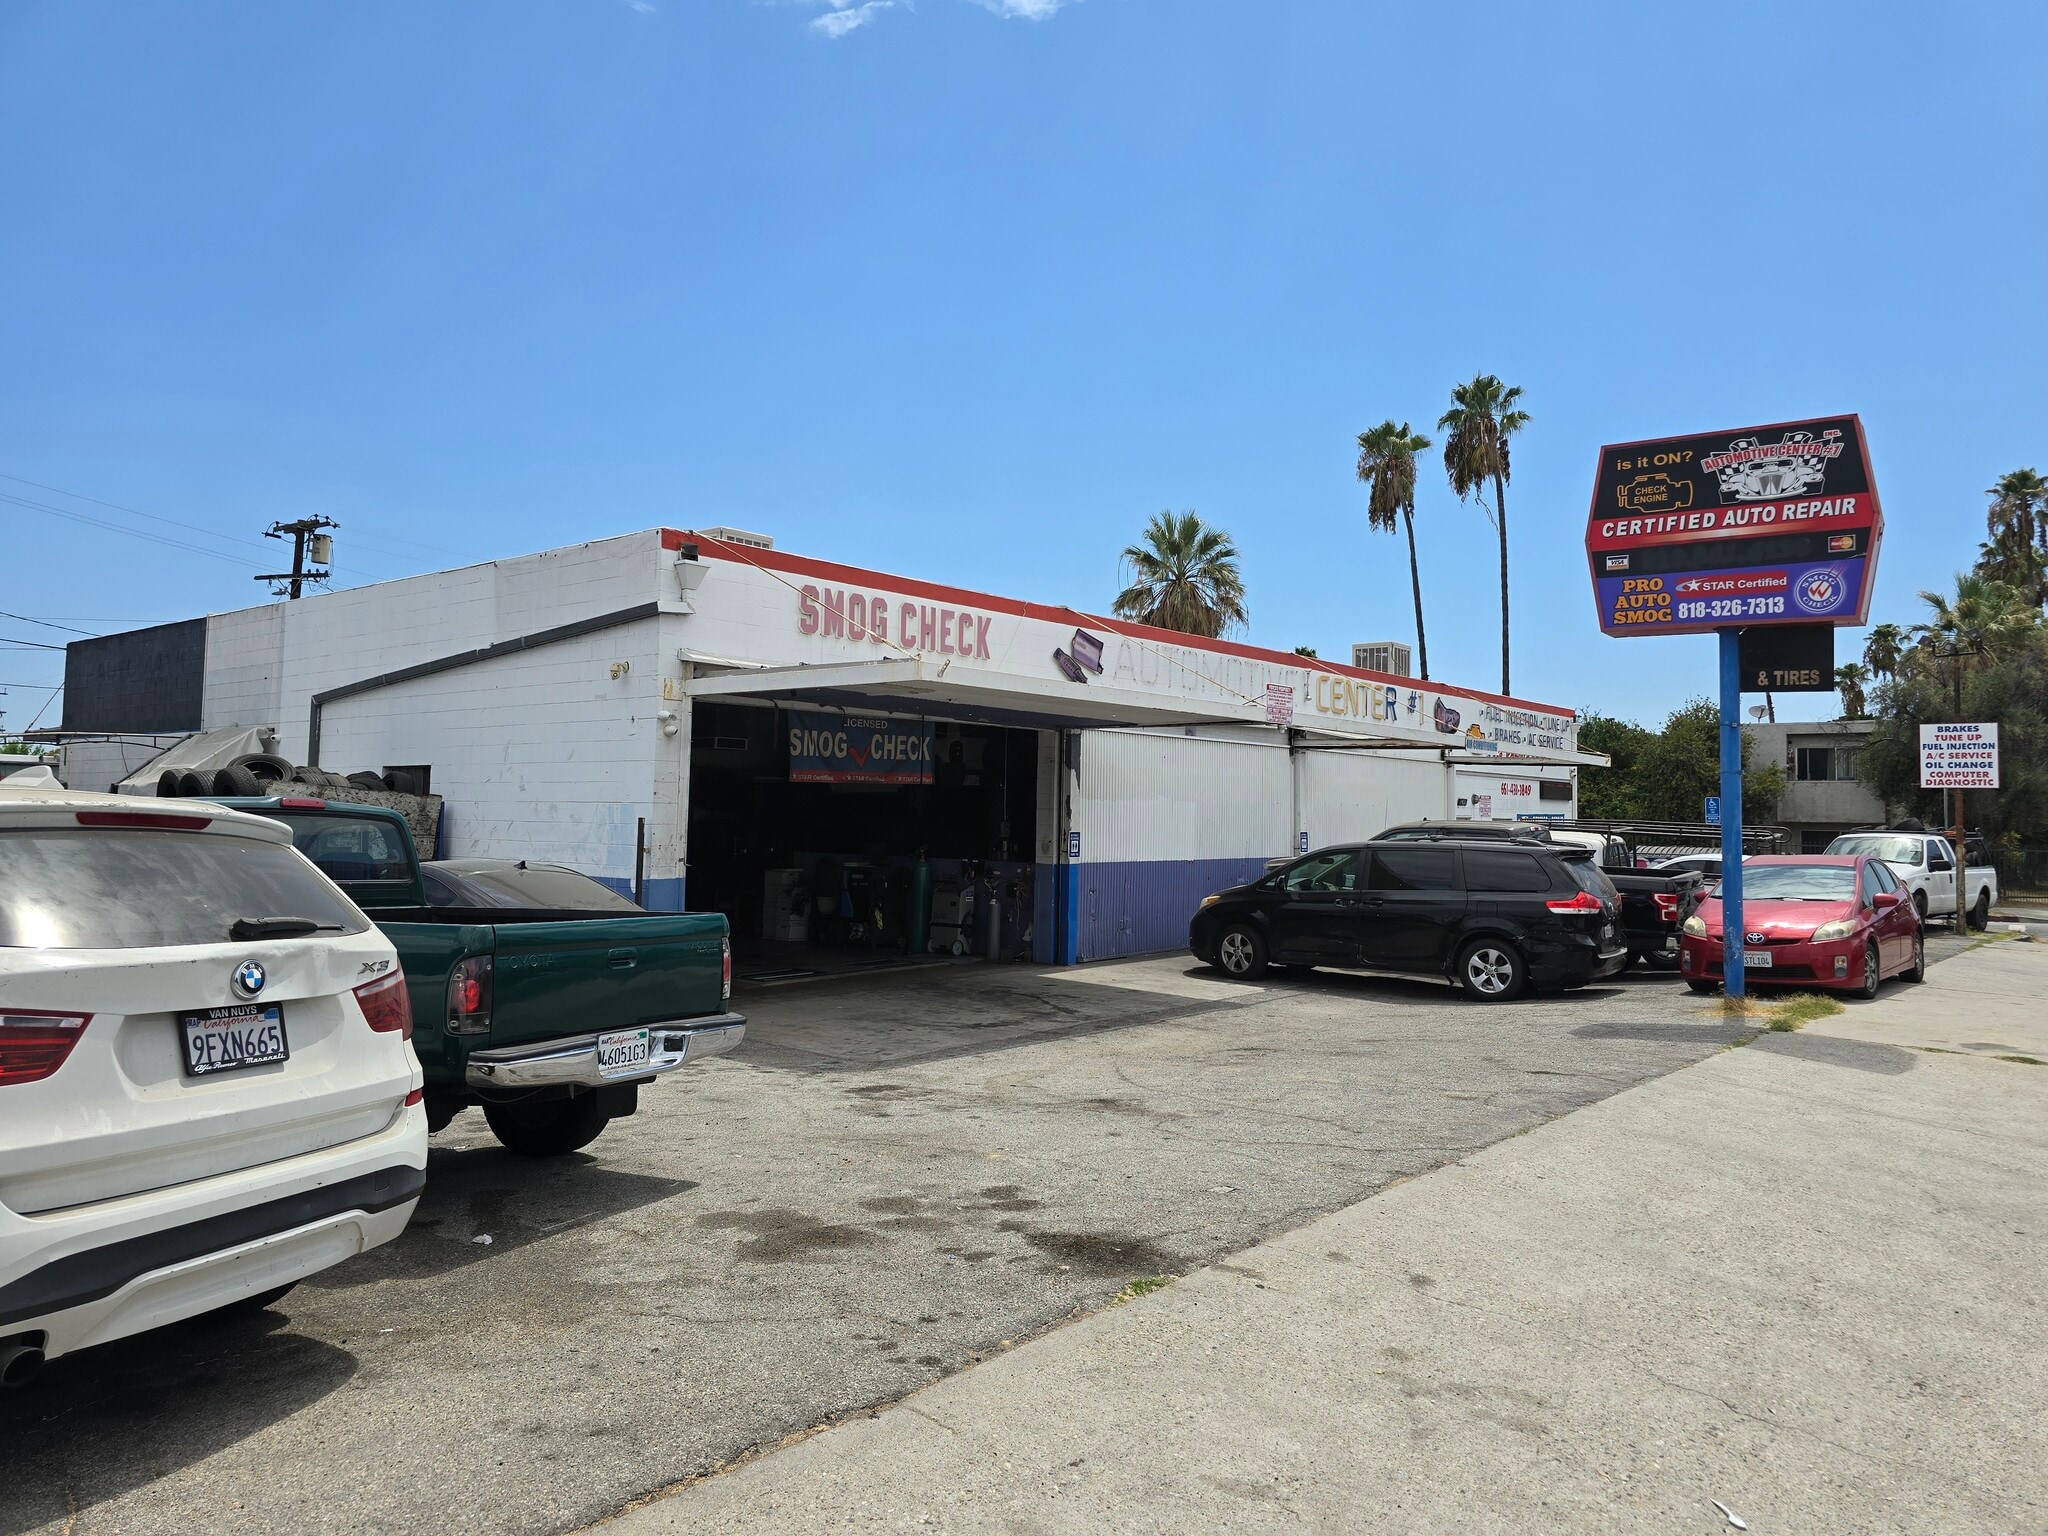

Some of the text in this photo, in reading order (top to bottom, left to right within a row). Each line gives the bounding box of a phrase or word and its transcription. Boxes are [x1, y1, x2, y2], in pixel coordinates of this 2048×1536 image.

[1823, 430, 1842, 438] INC.
[1617, 451, 1693, 470] is it ON?
[1703, 444, 1840, 470] AUTOMOTIVE CENTER #1
[1635, 485, 1667, 495] CHECK
[1634, 493, 1668, 504] ENGINE
[1602, 498, 1856, 537] CERTIFIED AUTO REPAIR
[1623, 577, 1664, 593] PRO
[1702, 577, 1787, 591] STAR Certified
[1802, 574, 1837, 588] SMOG
[1615, 593, 1671, 609] AUTO
[1678, 596, 1784, 618] 818-326-7313
[1802, 594, 1838, 608] CHECK
[799, 584, 992, 660] SMOG CHECK
[1614, 608, 1672, 624] SMOG
[1758, 669, 1820, 686] & TIRES
[1316, 675, 1397, 722] CENTER
[1407, 690, 1424, 725] #1
[1484, 706, 1503, 722] FUEL
[1494, 728, 1521, 744] BRAKES
[1937, 725, 1979, 733] BRAKES
[790, 728, 931, 761] SMOG CHECK
[1926, 752, 1945, 760] A/C
[357, 960, 390, 975] X3
[499, 954, 556, 969] TOYOTA
[1745, 957, 1770, 965] STL104
[209, 1005, 257, 1018] VAN NUYS
[203, 1015, 264, 1031] California
[192, 1025, 280, 1065] 9FXN665
[244, 1053, 285, 1064] Maserati
[601, 1043, 646, 1067] 46051G3
